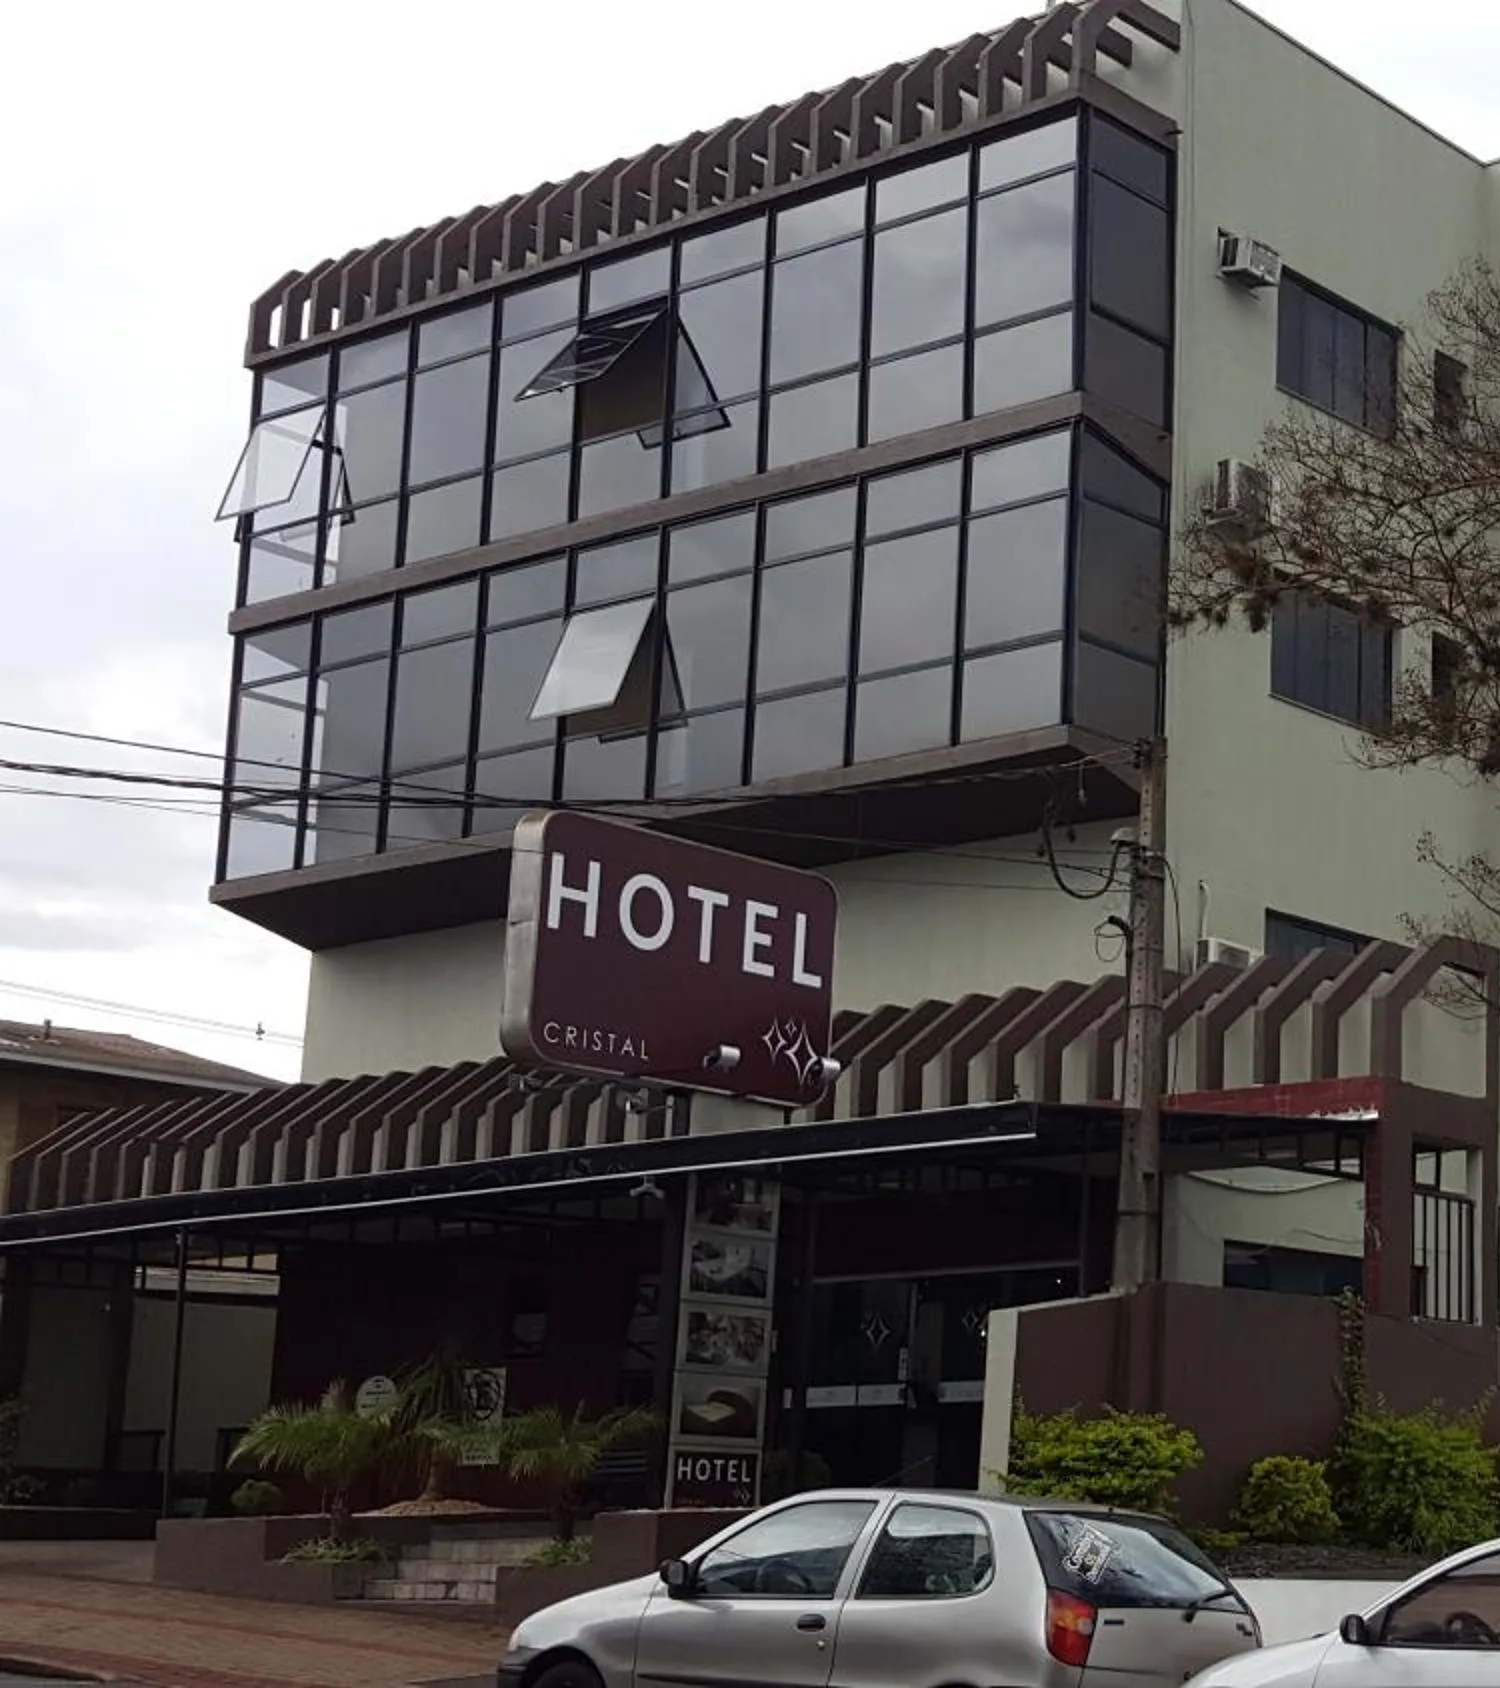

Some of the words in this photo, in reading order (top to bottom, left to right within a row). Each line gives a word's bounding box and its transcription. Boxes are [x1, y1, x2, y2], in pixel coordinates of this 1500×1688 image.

[547, 851, 822, 988] HOTEL
[543, 1022, 649, 1060] CRISTAL
[677, 1457, 751, 1483] HOTEL
